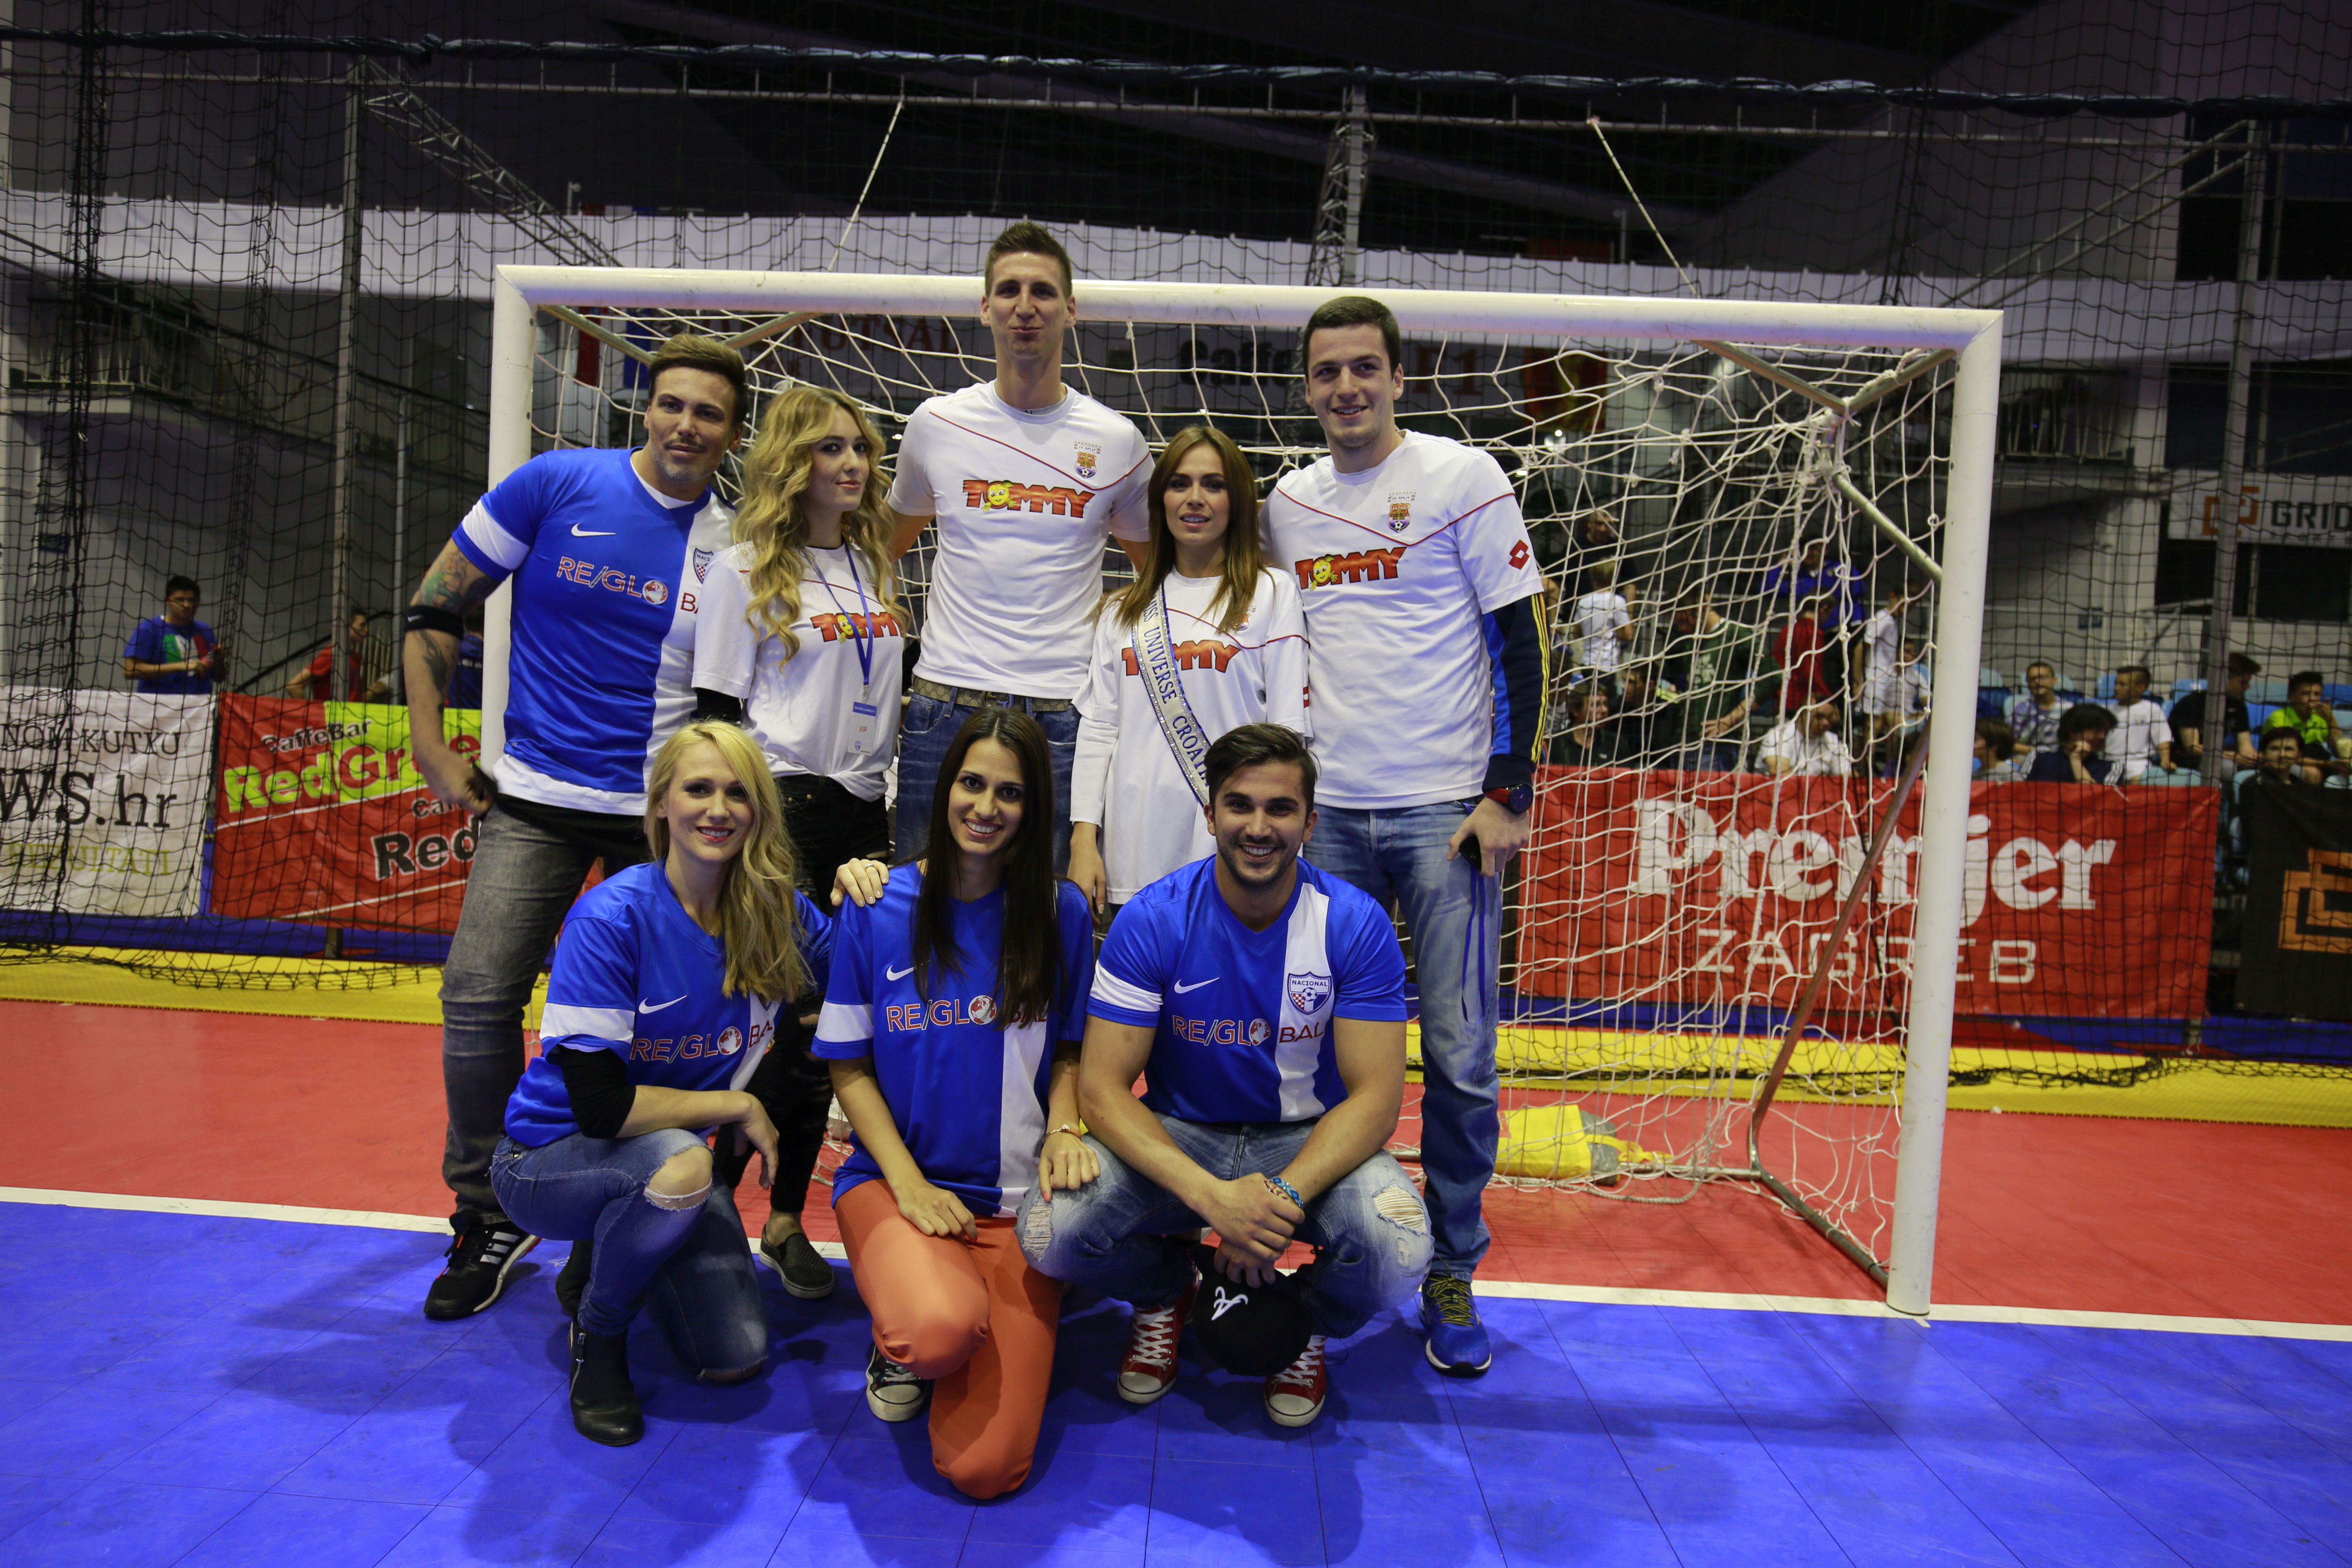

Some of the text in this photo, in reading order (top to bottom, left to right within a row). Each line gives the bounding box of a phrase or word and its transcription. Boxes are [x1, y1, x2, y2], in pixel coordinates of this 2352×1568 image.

[962, 479, 1096, 519] TOMMY
[1295, 546, 1408, 590] TOMMY
[1122, 639, 1242, 676] TMMY
[1144, 626, 1177, 704] UNIVERSE
